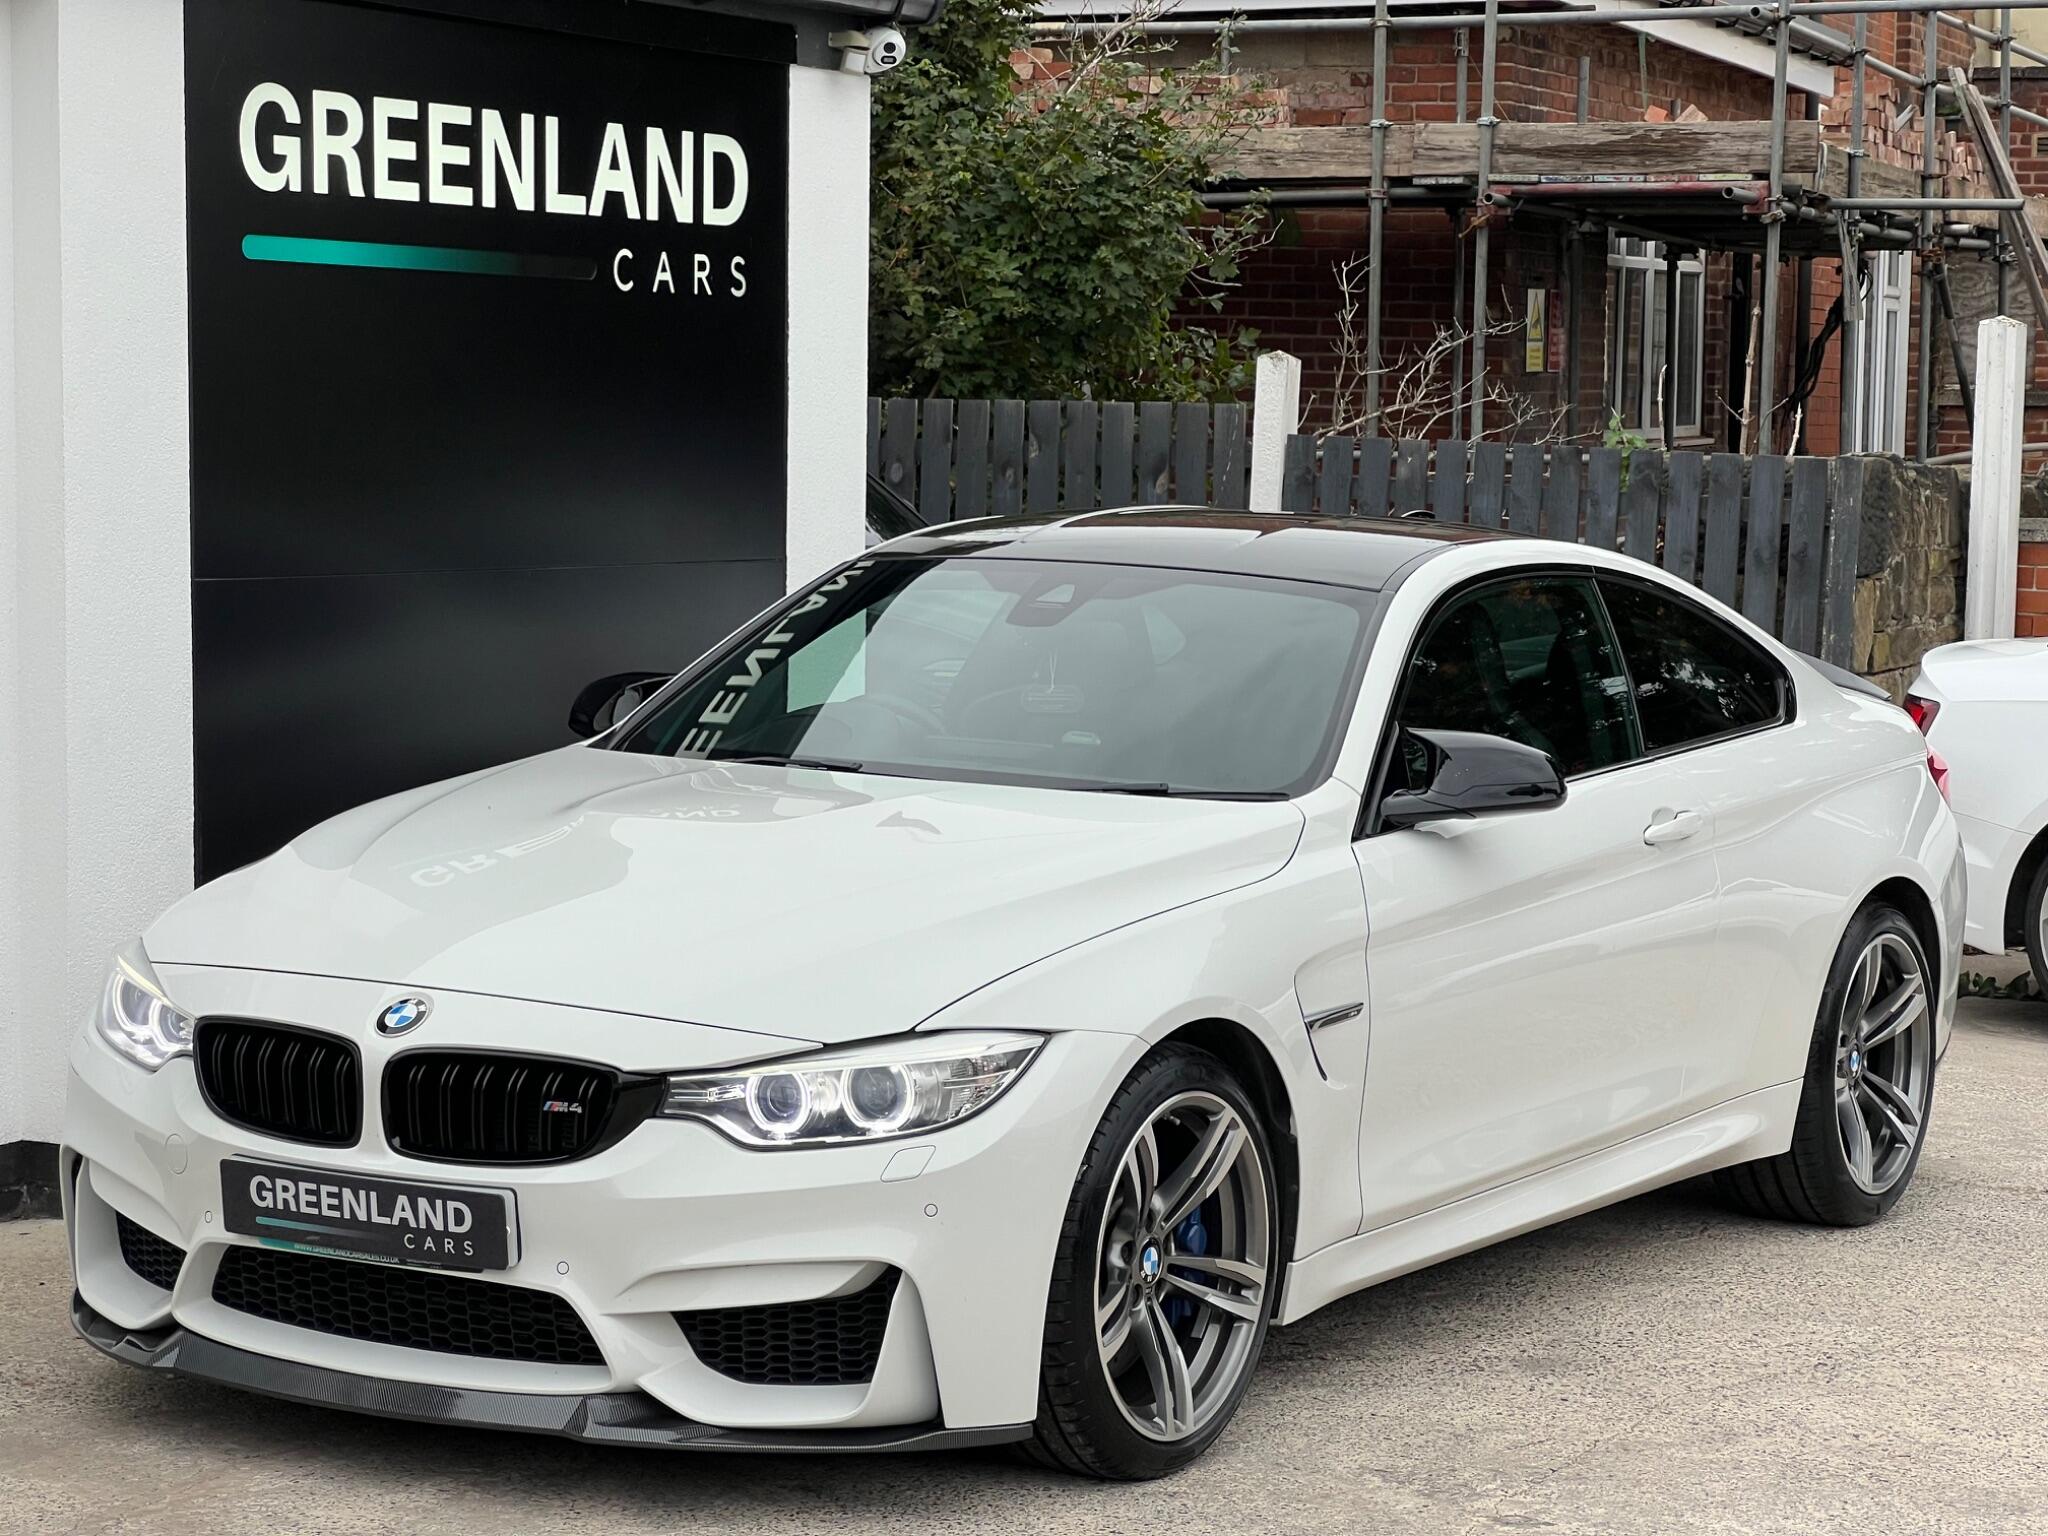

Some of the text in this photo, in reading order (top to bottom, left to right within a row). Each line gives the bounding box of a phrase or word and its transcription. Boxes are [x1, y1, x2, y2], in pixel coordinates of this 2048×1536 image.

[239, 82, 749, 226] GREENLAND
[613, 248, 748, 297] CARS
[543, 1100, 582, 1113] M4
[249, 1174, 473, 1234] GREENLAND
[403, 1233, 474, 1256] CARS
